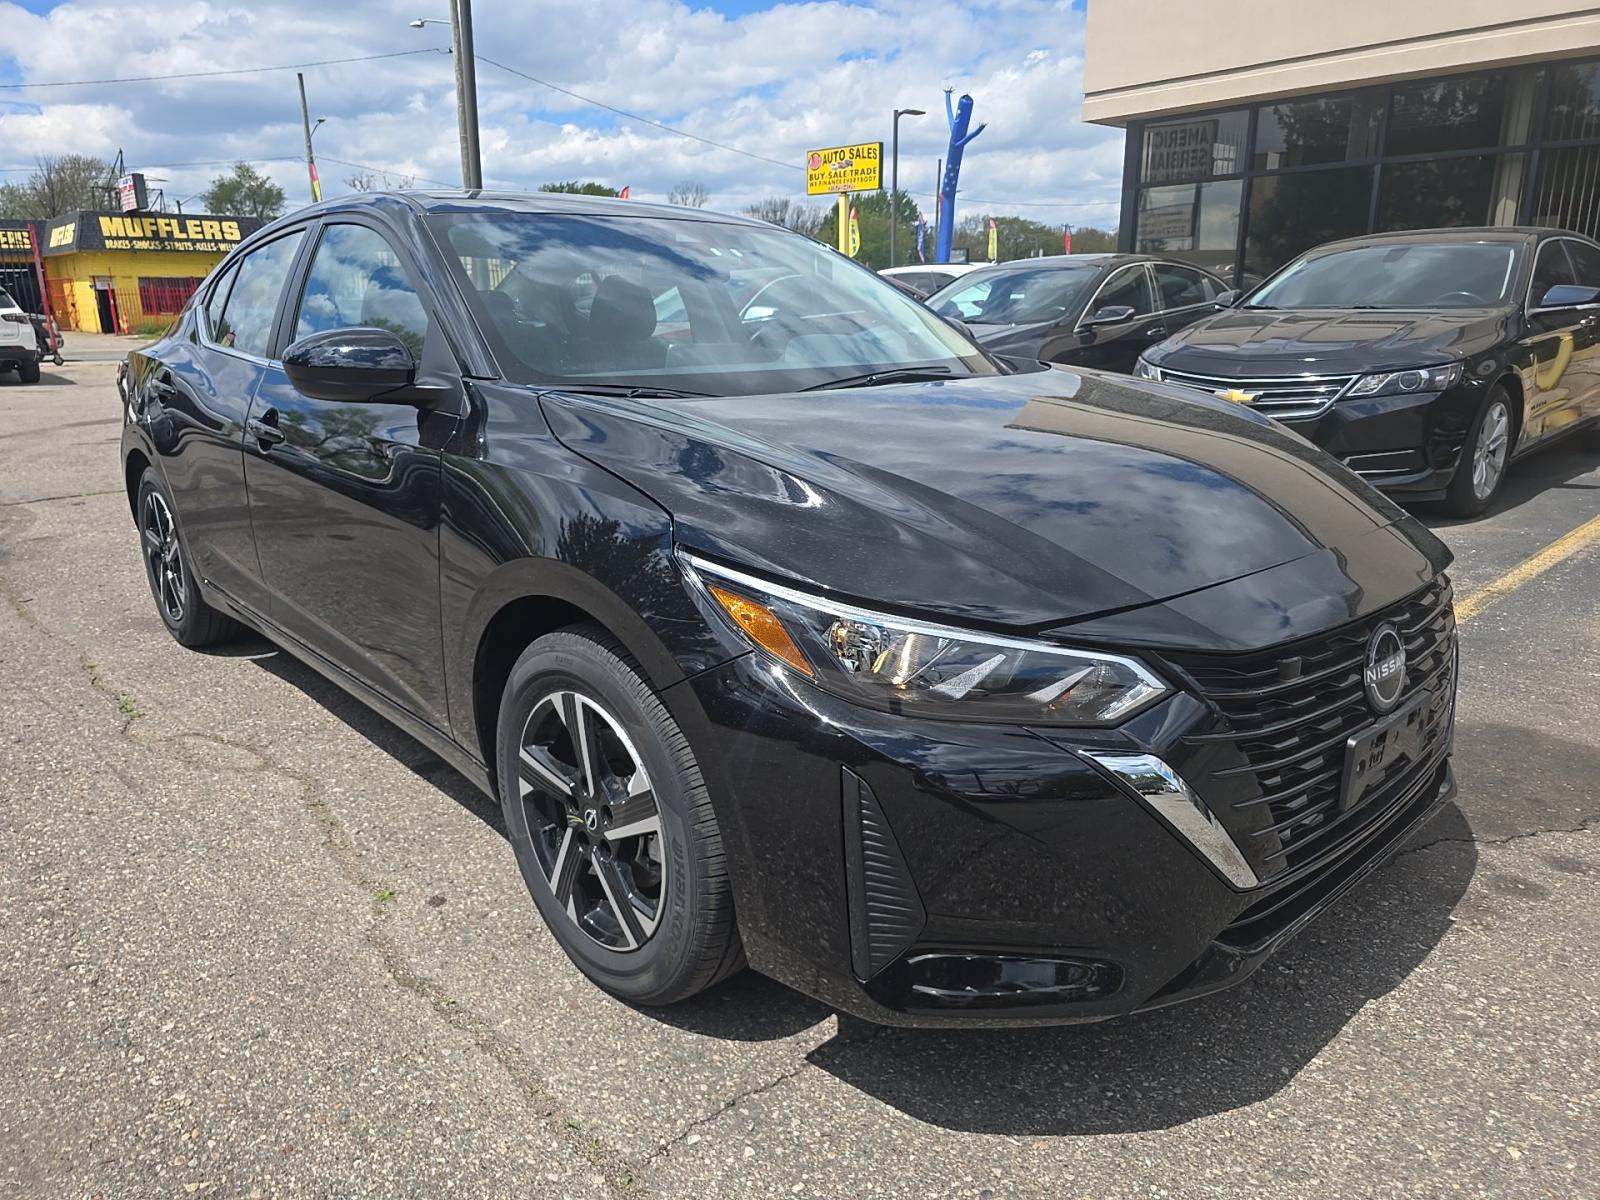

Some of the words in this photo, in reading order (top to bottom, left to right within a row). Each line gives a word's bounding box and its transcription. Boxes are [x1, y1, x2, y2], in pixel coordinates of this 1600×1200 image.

[823, 149, 845, 164] AUTO
[848, 147, 878, 160] SALES
[809, 172, 825, 181] BUY
[828, 169, 847, 179] SALE
[850, 167, 877, 177] TRADE
[99, 216, 241, 241] MUFFLERS
[1366, 653, 1405, 682] NISSAN
